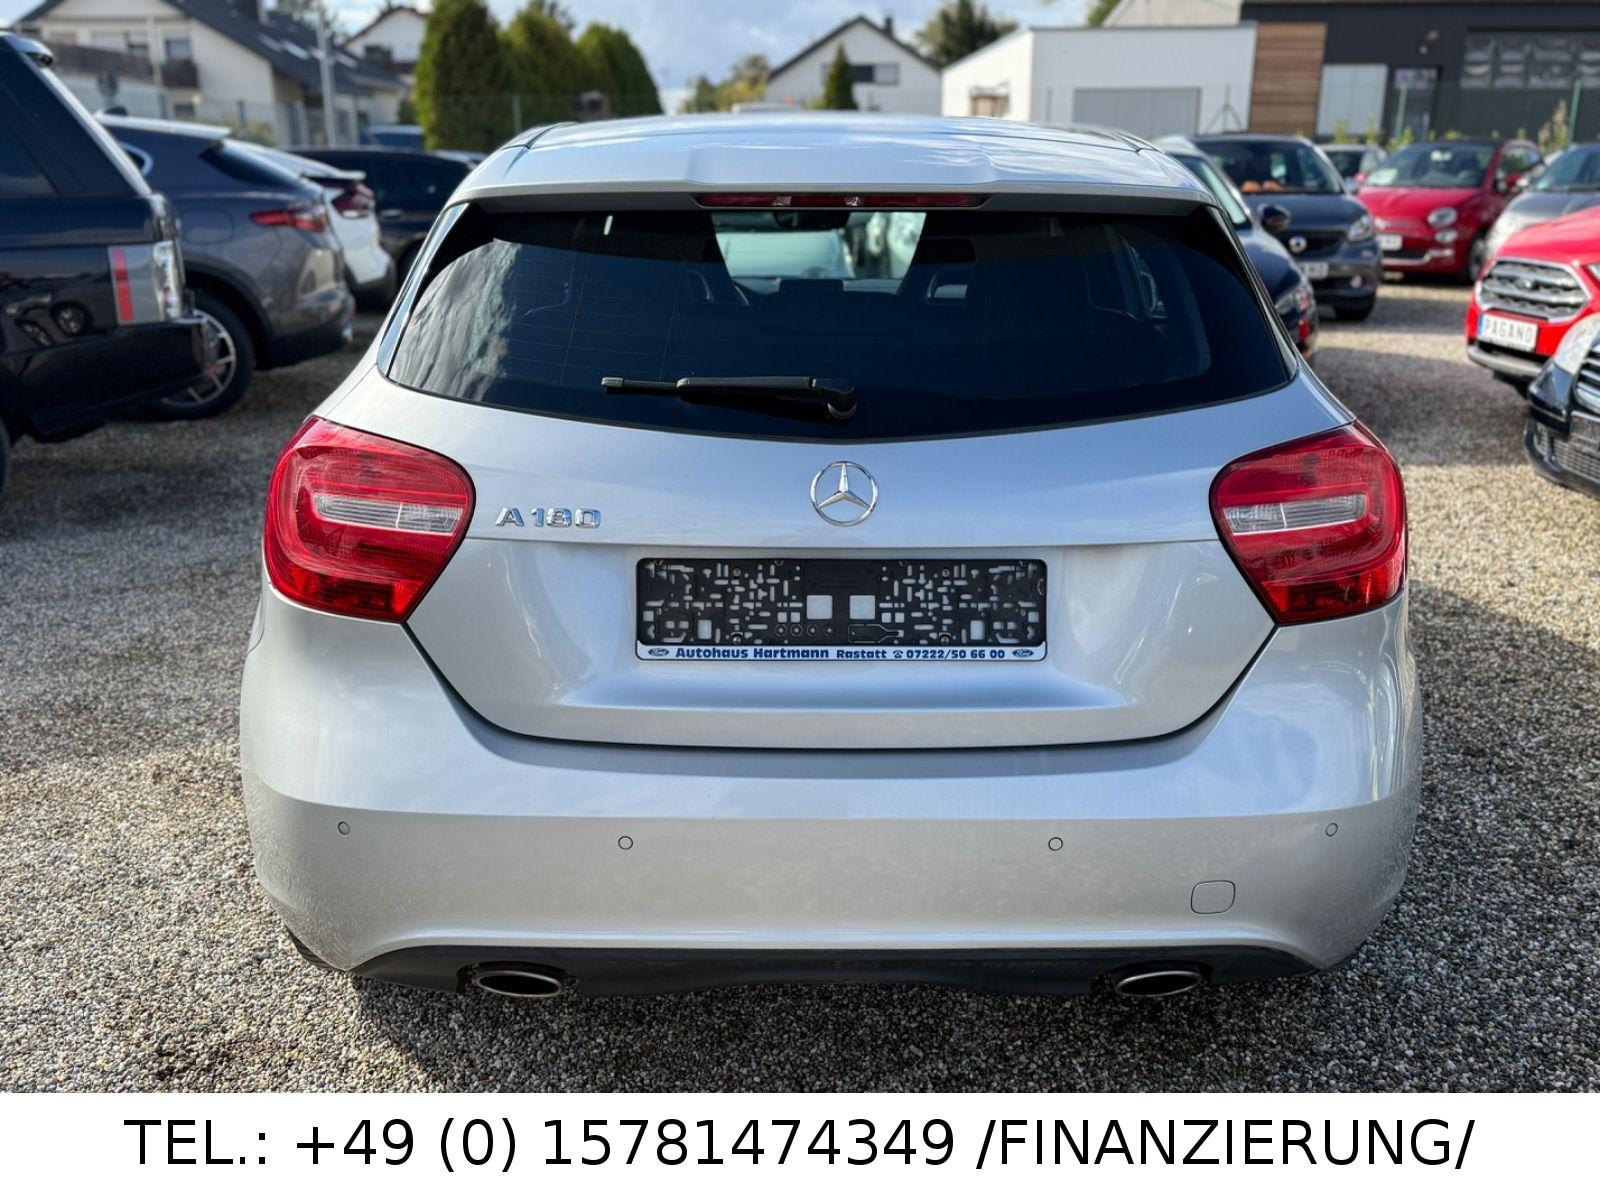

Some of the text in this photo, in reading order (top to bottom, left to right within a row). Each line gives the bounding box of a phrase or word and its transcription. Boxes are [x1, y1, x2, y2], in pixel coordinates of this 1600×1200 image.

[675, 647, 1005, 660] Autohaus Hartmann Rastatt 07222/50 66 00
